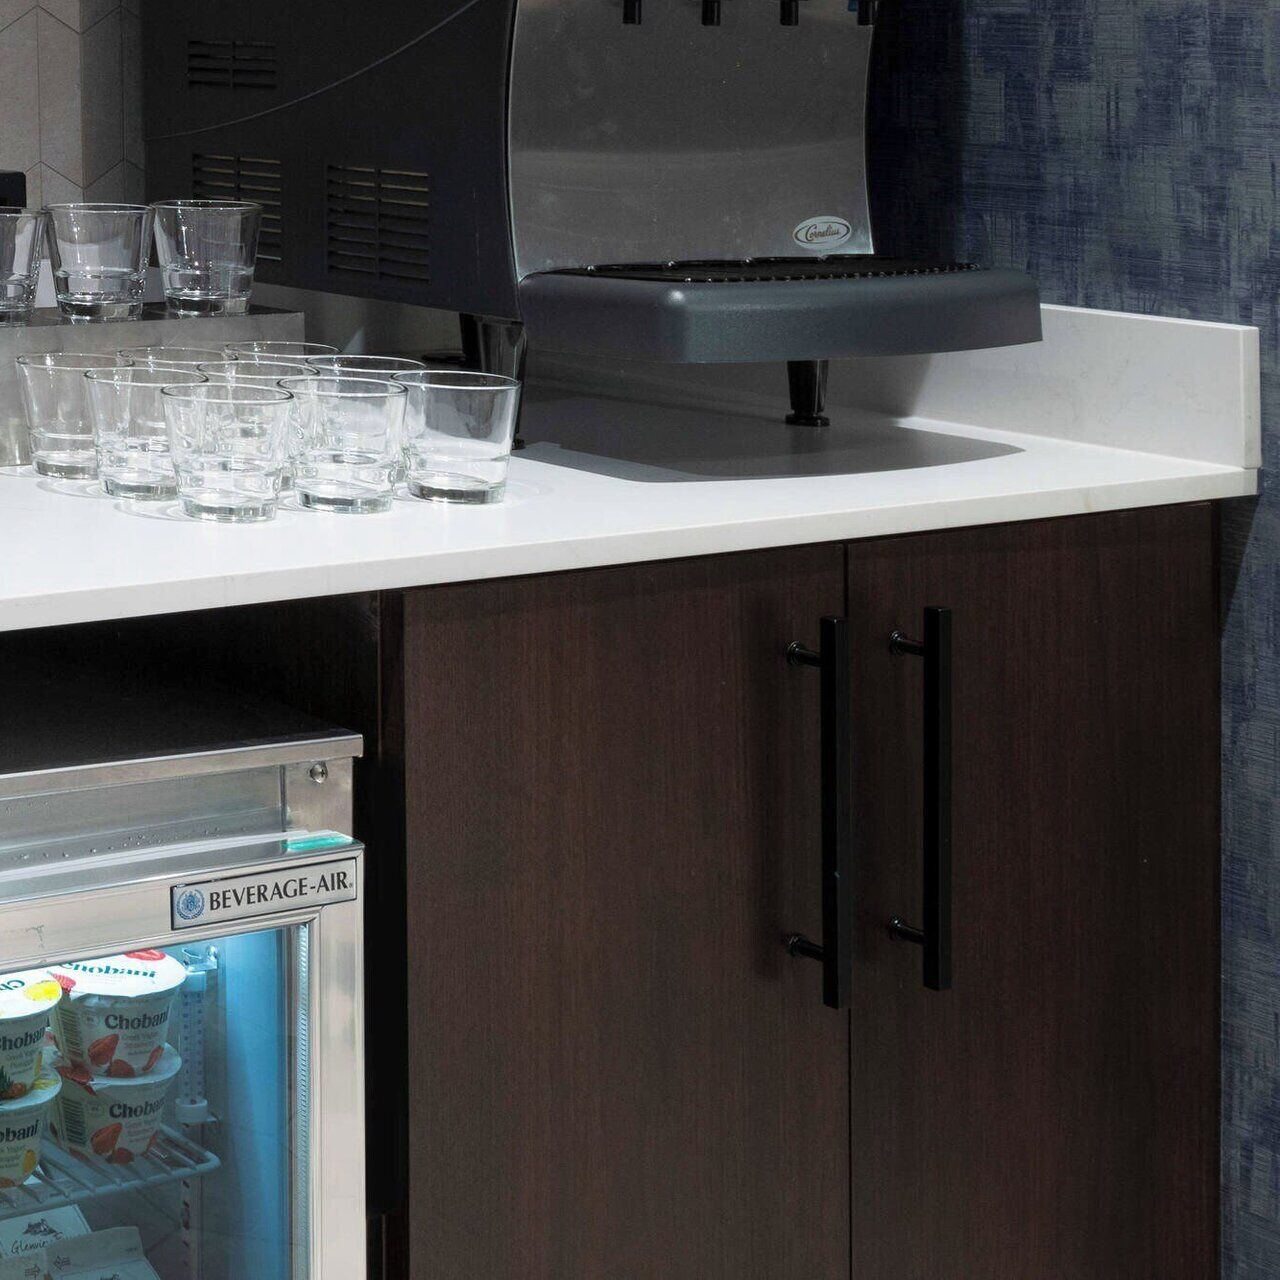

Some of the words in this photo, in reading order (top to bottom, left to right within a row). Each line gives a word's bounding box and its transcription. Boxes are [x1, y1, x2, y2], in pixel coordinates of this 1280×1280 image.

[805, 223, 840, 242] Cornelius
[209, 871, 349, 911] BEVERAGE-AIR
[11, 1240, 47, 1255] Glenvie
